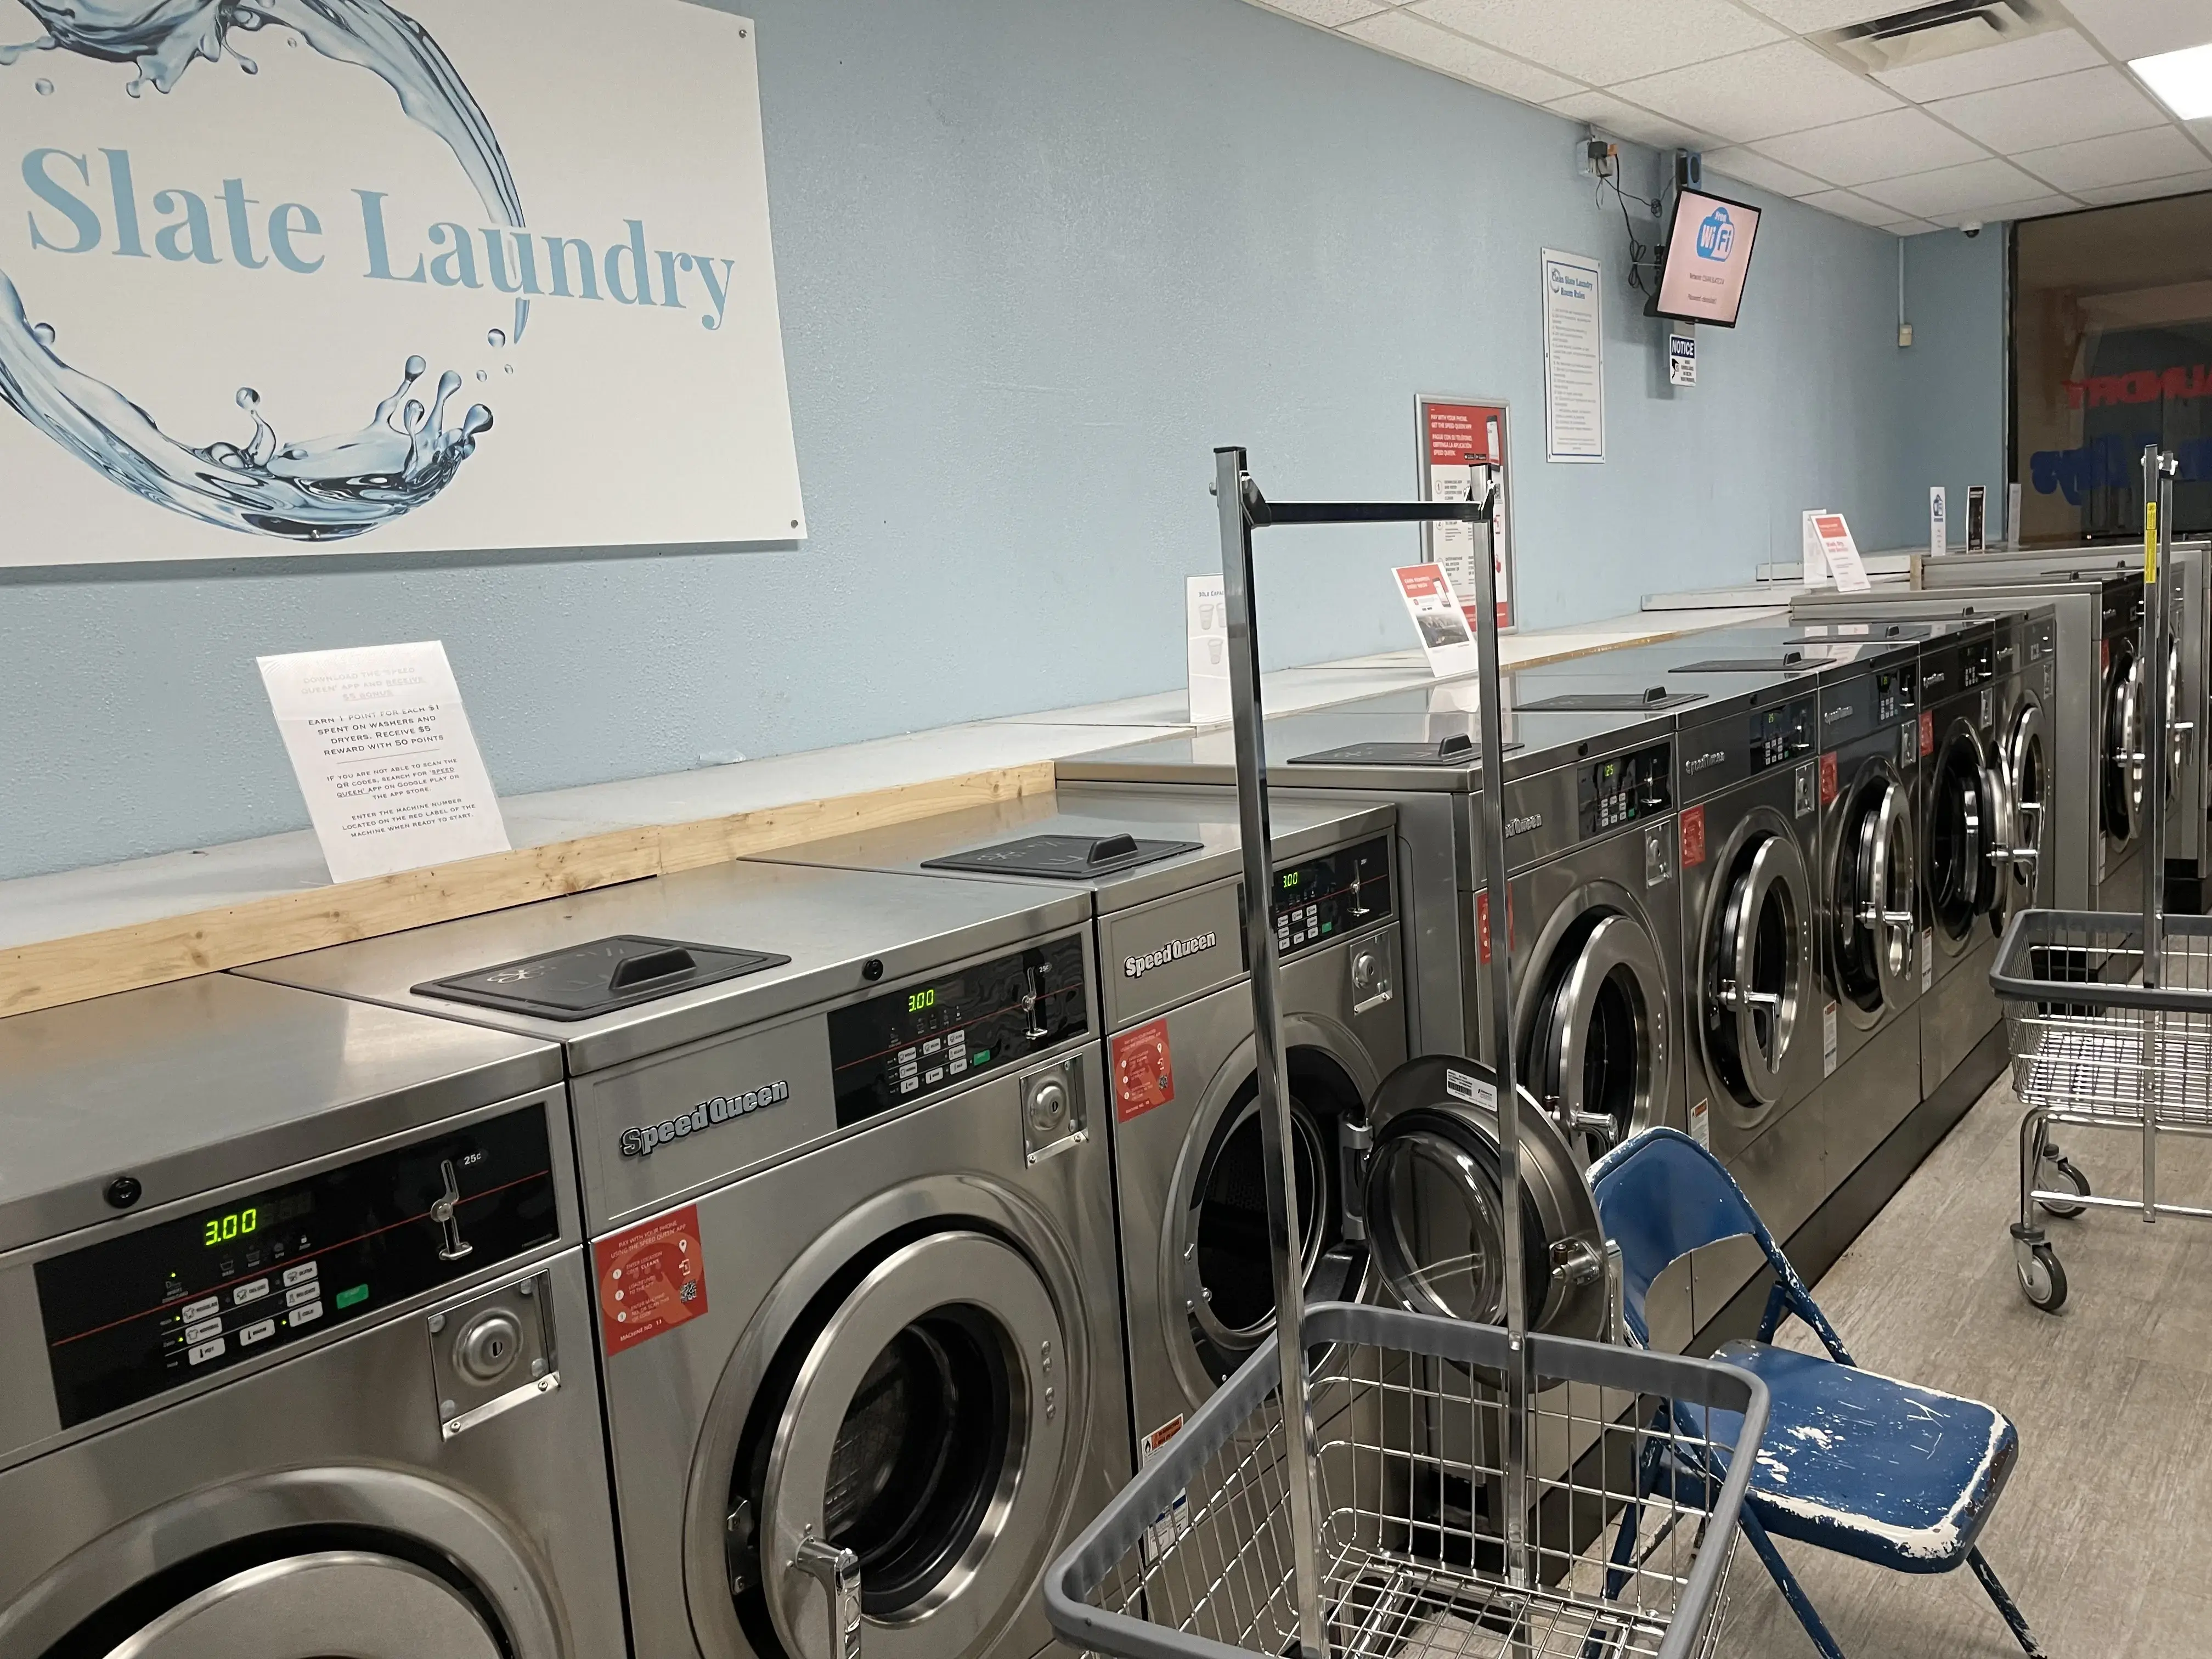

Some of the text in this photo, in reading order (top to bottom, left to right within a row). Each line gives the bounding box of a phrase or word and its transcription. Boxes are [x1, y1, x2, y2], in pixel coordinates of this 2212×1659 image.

[1716, 211, 1727, 222] Free
[21, 146, 735, 330] Slate Laundry
[1672, 340, 1694, 356] NOTICE
[318, 726, 348, 735] SPENT
[369, 718, 414, 729] WASHERS
[348, 713, 376, 721] POINT
[324, 746, 365, 755] REWARD
[411, 735, 444, 744] POINTS
[352, 812, 376, 820] ENTER
[396, 803, 429, 812] MACHINE
[431, 798, 461, 806] NUMBER
[342, 821, 376, 831] LOCATED
[351, 828, 385, 837] MACHINE
[1515, 814, 1543, 834] Queen
[1125, 932, 1216, 979] Speed Queen
[909, 989, 934, 1012] 3.00
[620, 1080, 789, 1156] Speed Queen
[205, 1209, 256, 1245] 3.00
[644, 1228, 658, 1237] YOUR
[611, 1248, 628, 1259] USING
[639, 1237, 656, 1246] SPEED
[620, 1327, 643, 1341] MACHINE
